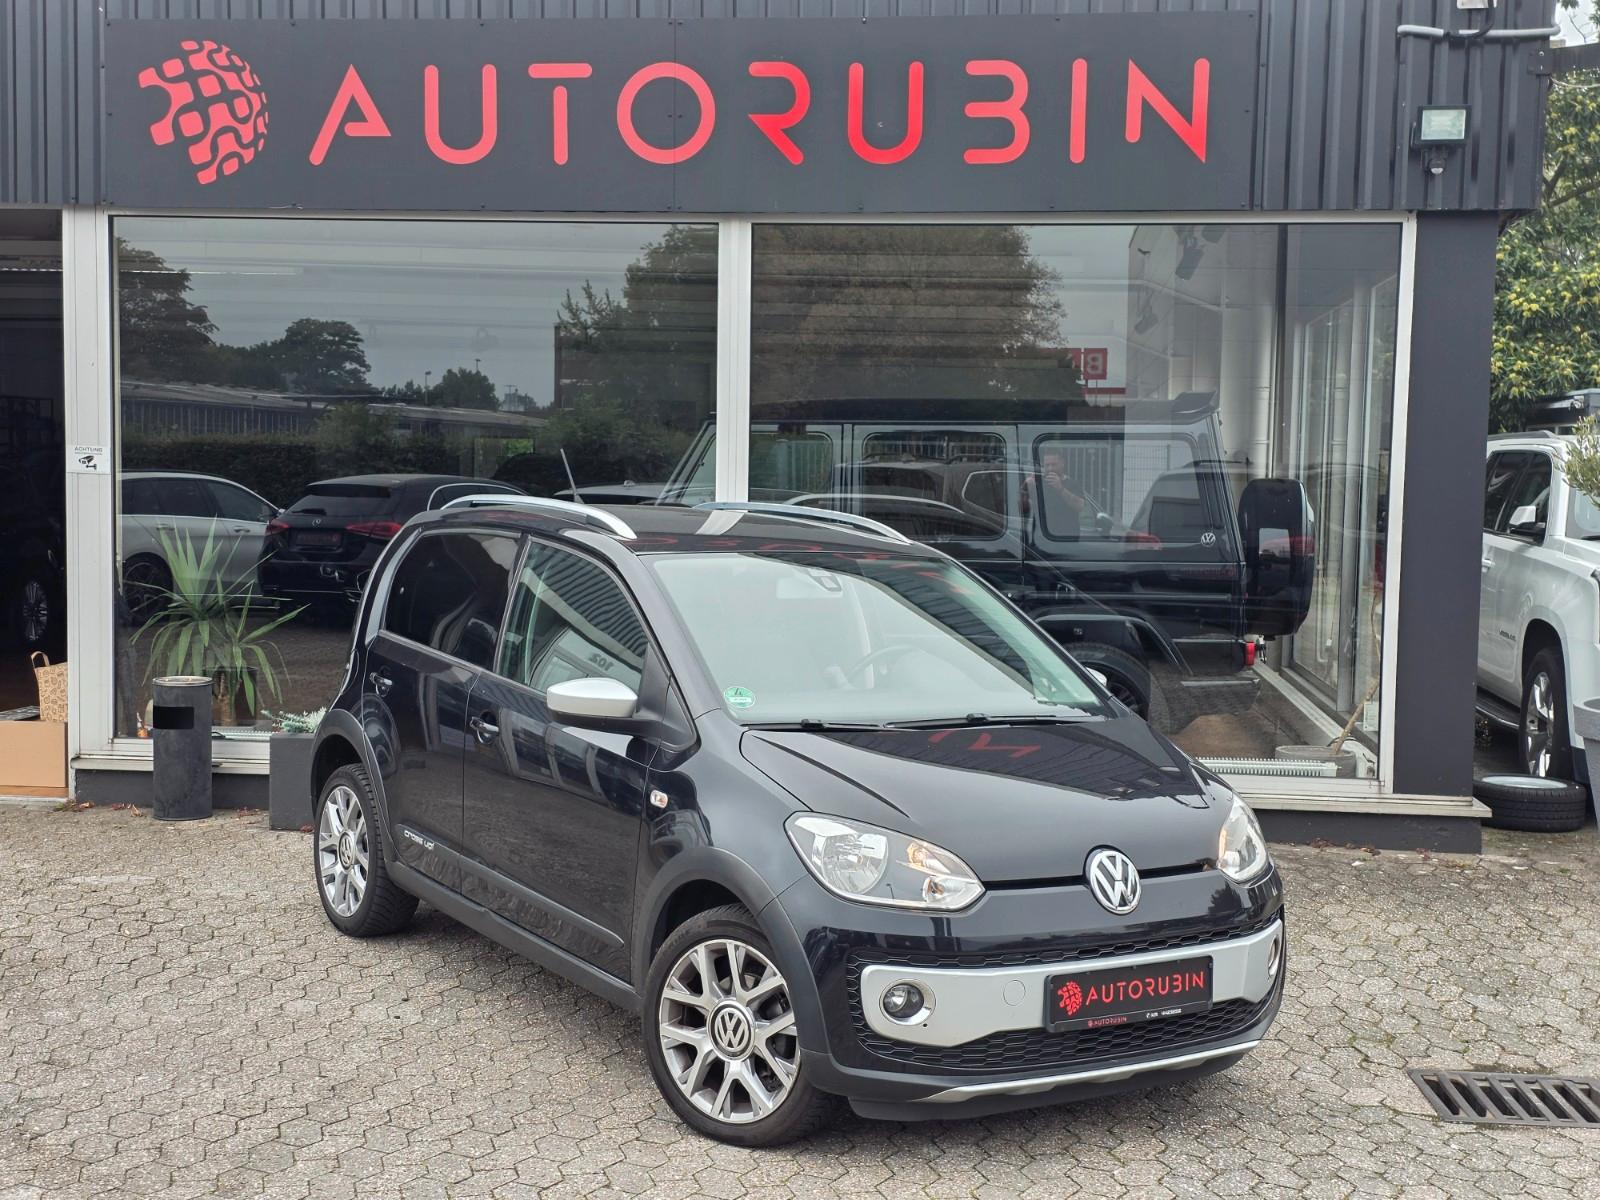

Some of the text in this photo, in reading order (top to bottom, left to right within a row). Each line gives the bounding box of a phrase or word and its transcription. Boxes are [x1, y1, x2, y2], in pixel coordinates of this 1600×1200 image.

[309, 57, 1211, 166] AUTORUBIN
[1085, 970, 1205, 1006] AUTORUBIN
[1094, 1016, 1127, 1026] AUTORUBIN
